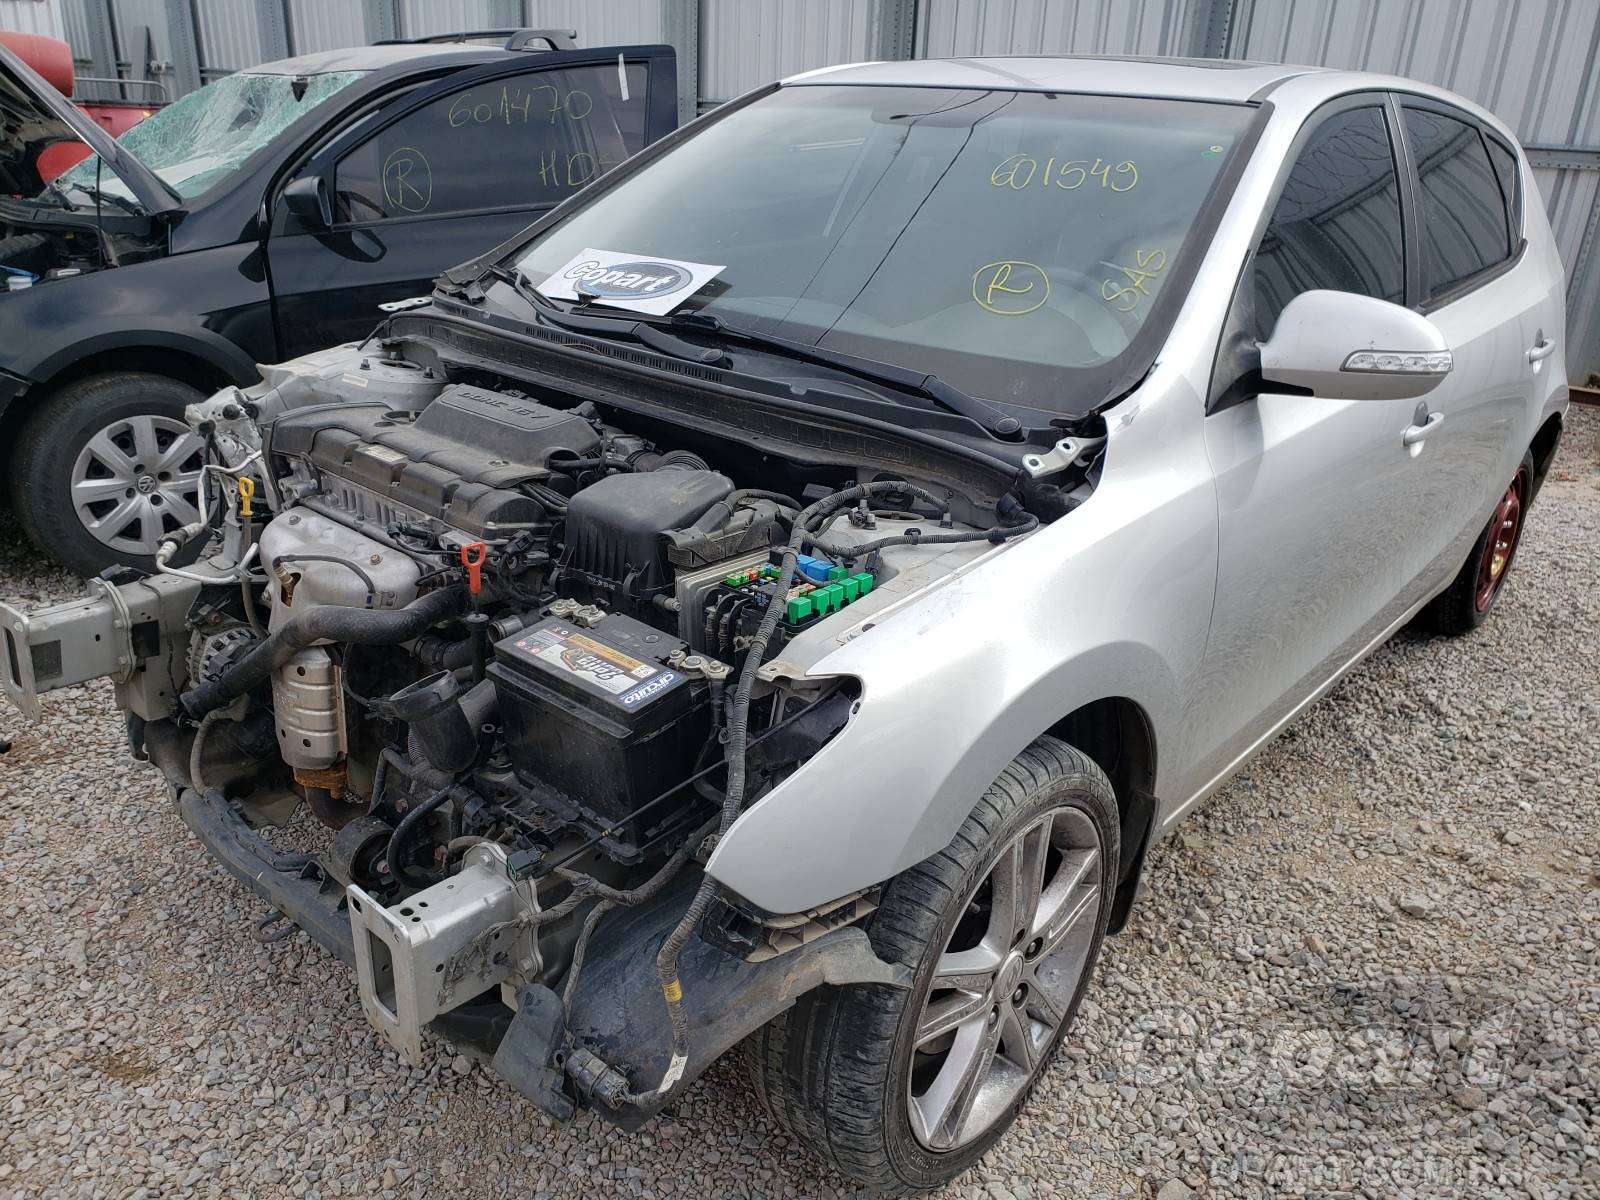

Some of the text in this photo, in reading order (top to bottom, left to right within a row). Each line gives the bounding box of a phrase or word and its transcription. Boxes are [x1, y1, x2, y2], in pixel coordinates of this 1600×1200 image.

[386, 157, 425, 207] R
[990, 153, 1139, 192] 601549
[563, 260, 680, 293] Copart
